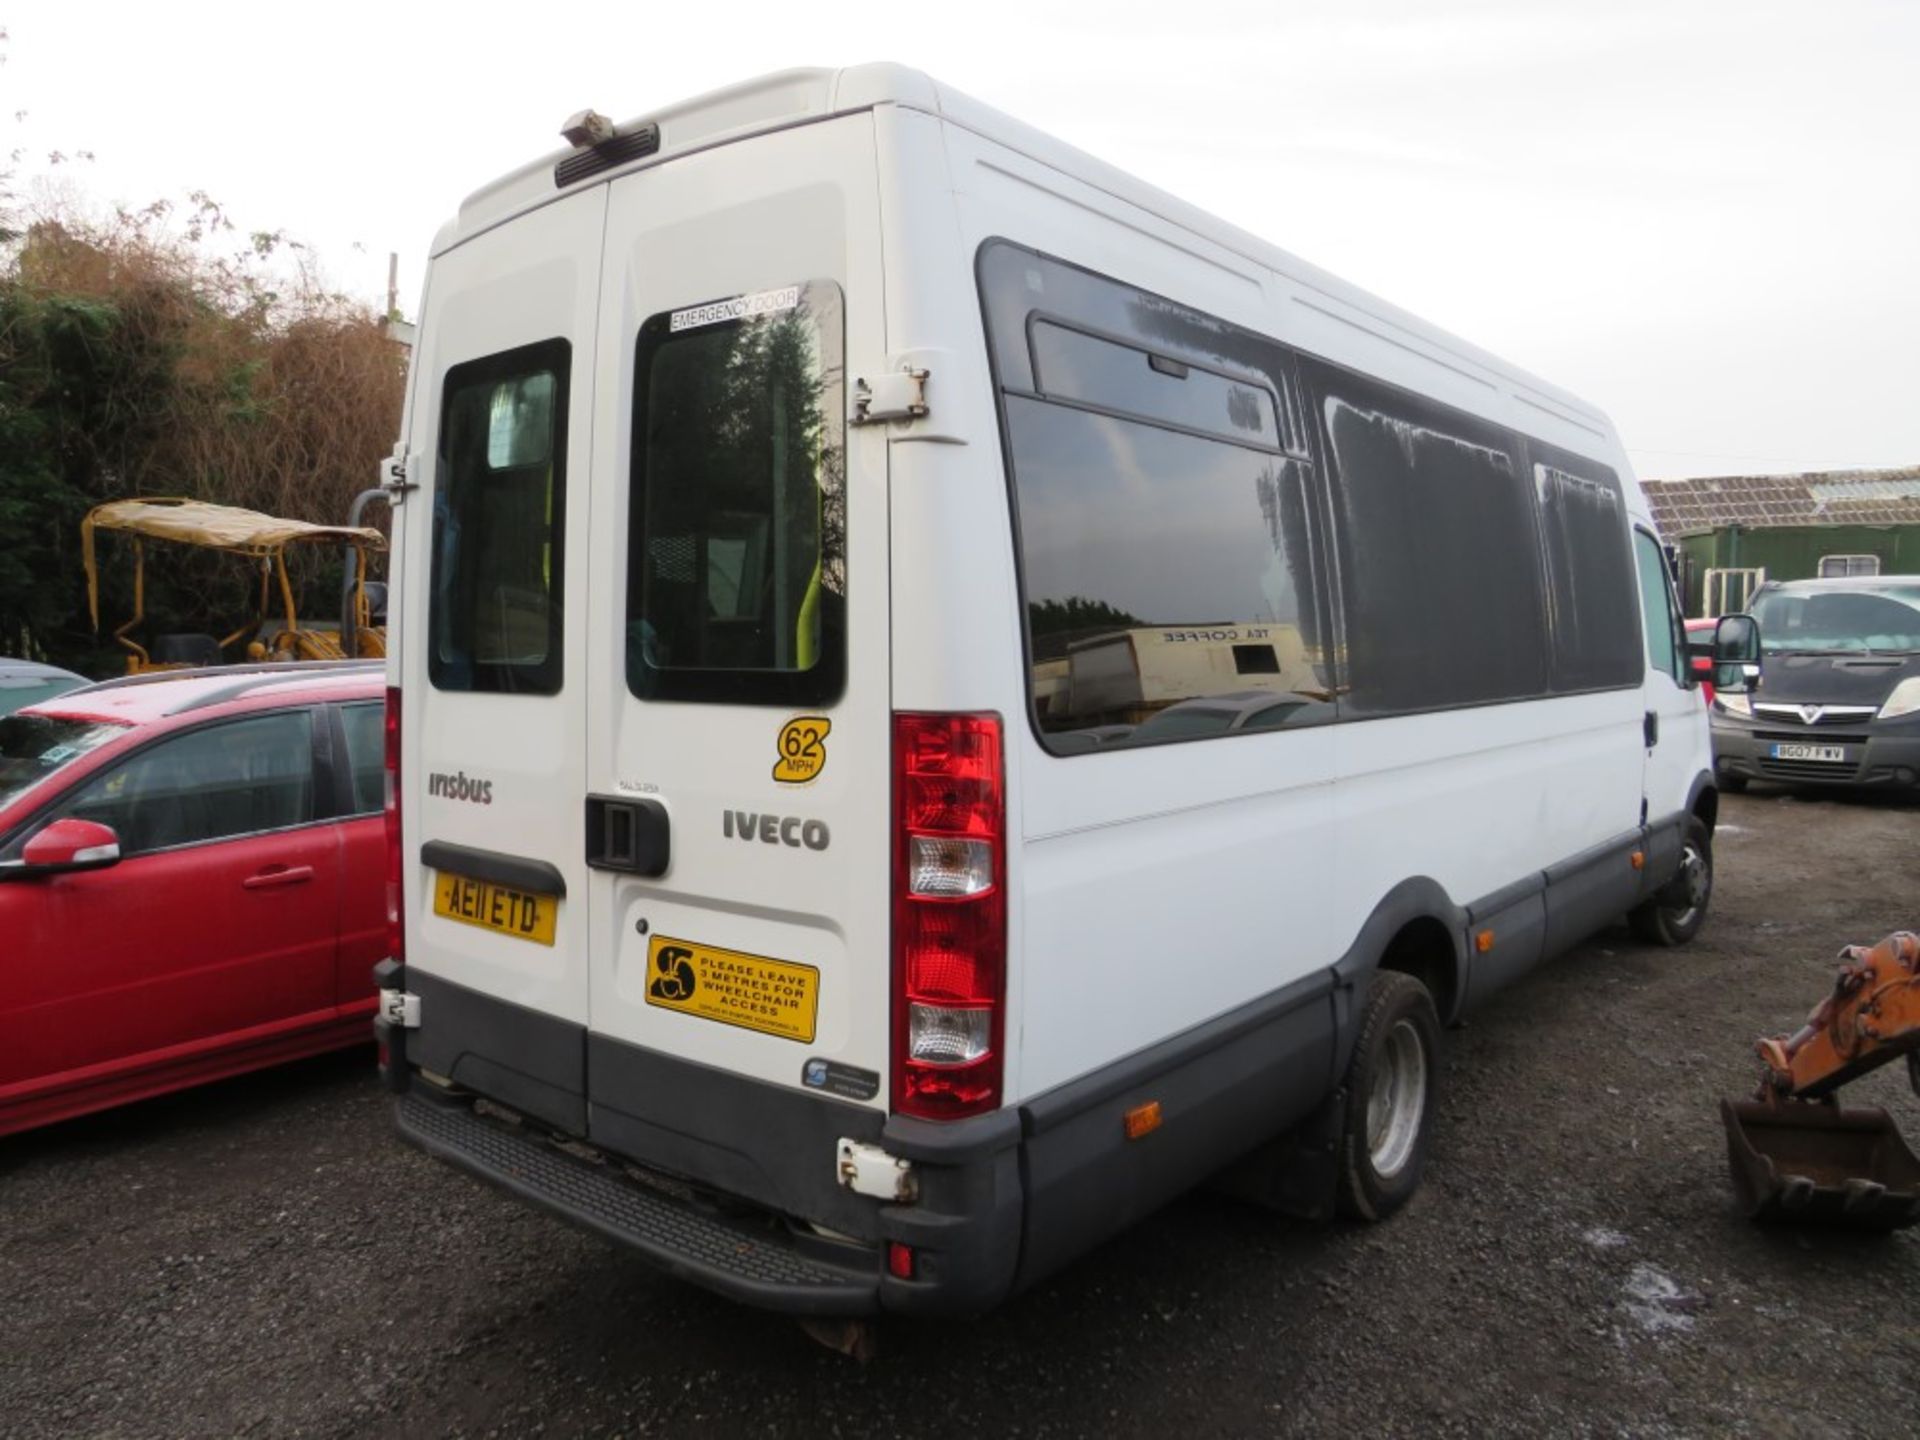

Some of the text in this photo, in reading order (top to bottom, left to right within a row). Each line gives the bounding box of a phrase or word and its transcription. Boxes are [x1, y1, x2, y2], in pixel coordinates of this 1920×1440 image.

[672, 290, 797, 329] EMERGENCY DOOR
[785, 727, 819, 758] 62
[786, 758, 815, 773] MPH
[723, 809, 831, 851] IVECO
[449, 879, 537, 933] AE11 ETD
[700, 957, 806, 988] PLEASE LEAVE
[700, 969, 804, 999] 3 METRES FOR
[703, 981, 799, 1009] WHEELCHAIR
[720, 996, 778, 1016] ACCESS
